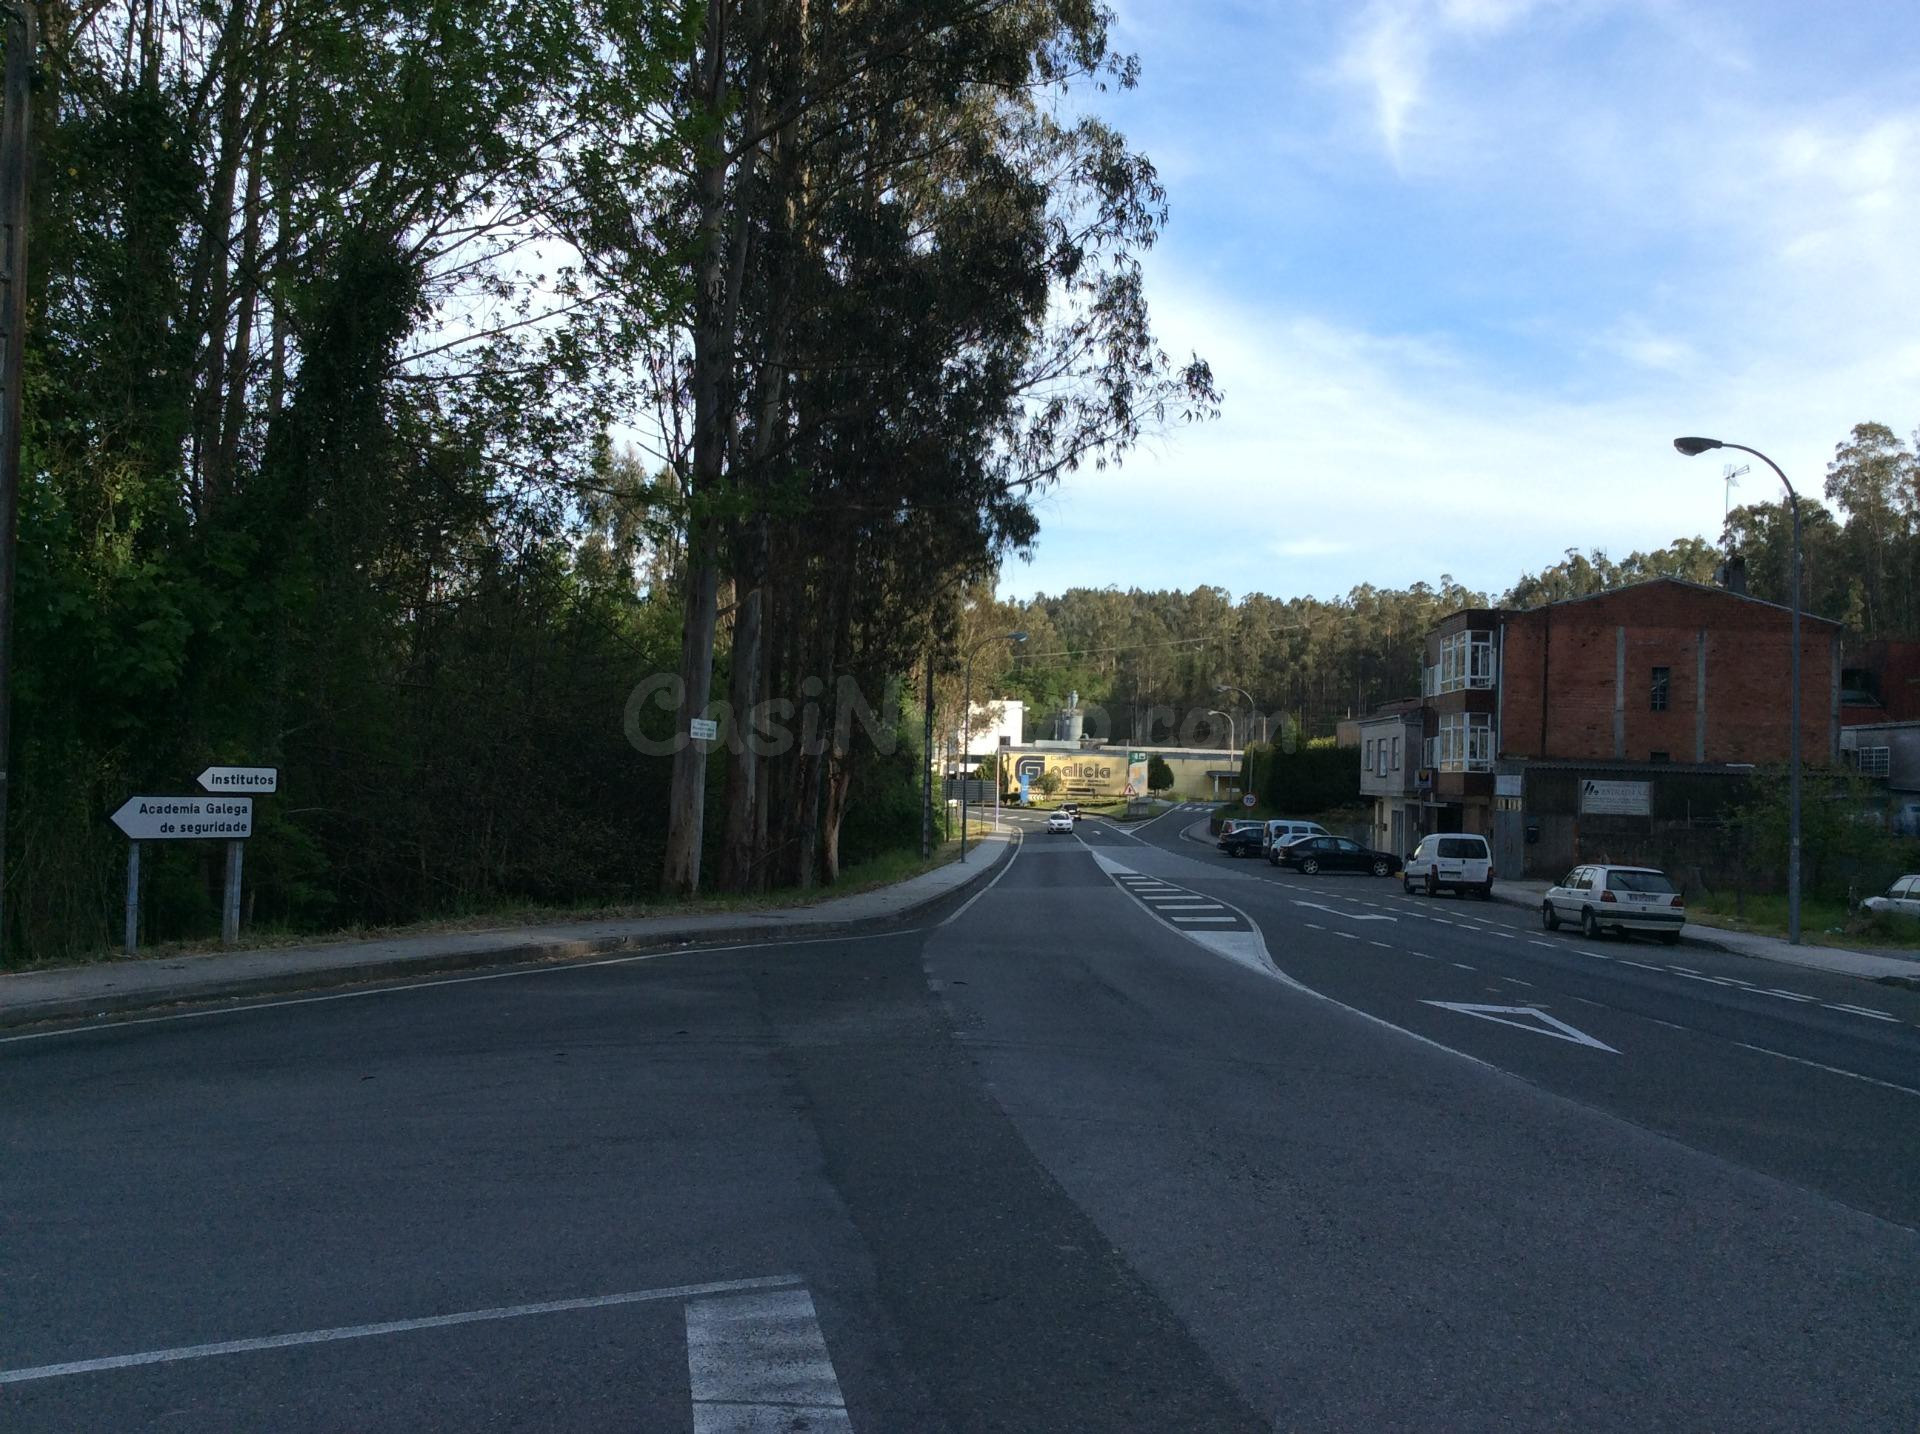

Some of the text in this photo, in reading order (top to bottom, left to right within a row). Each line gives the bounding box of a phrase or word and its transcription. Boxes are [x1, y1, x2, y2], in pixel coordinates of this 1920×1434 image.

[139, 802, 248, 816] Academia Galega
[160, 820, 248, 834] de seguridade
